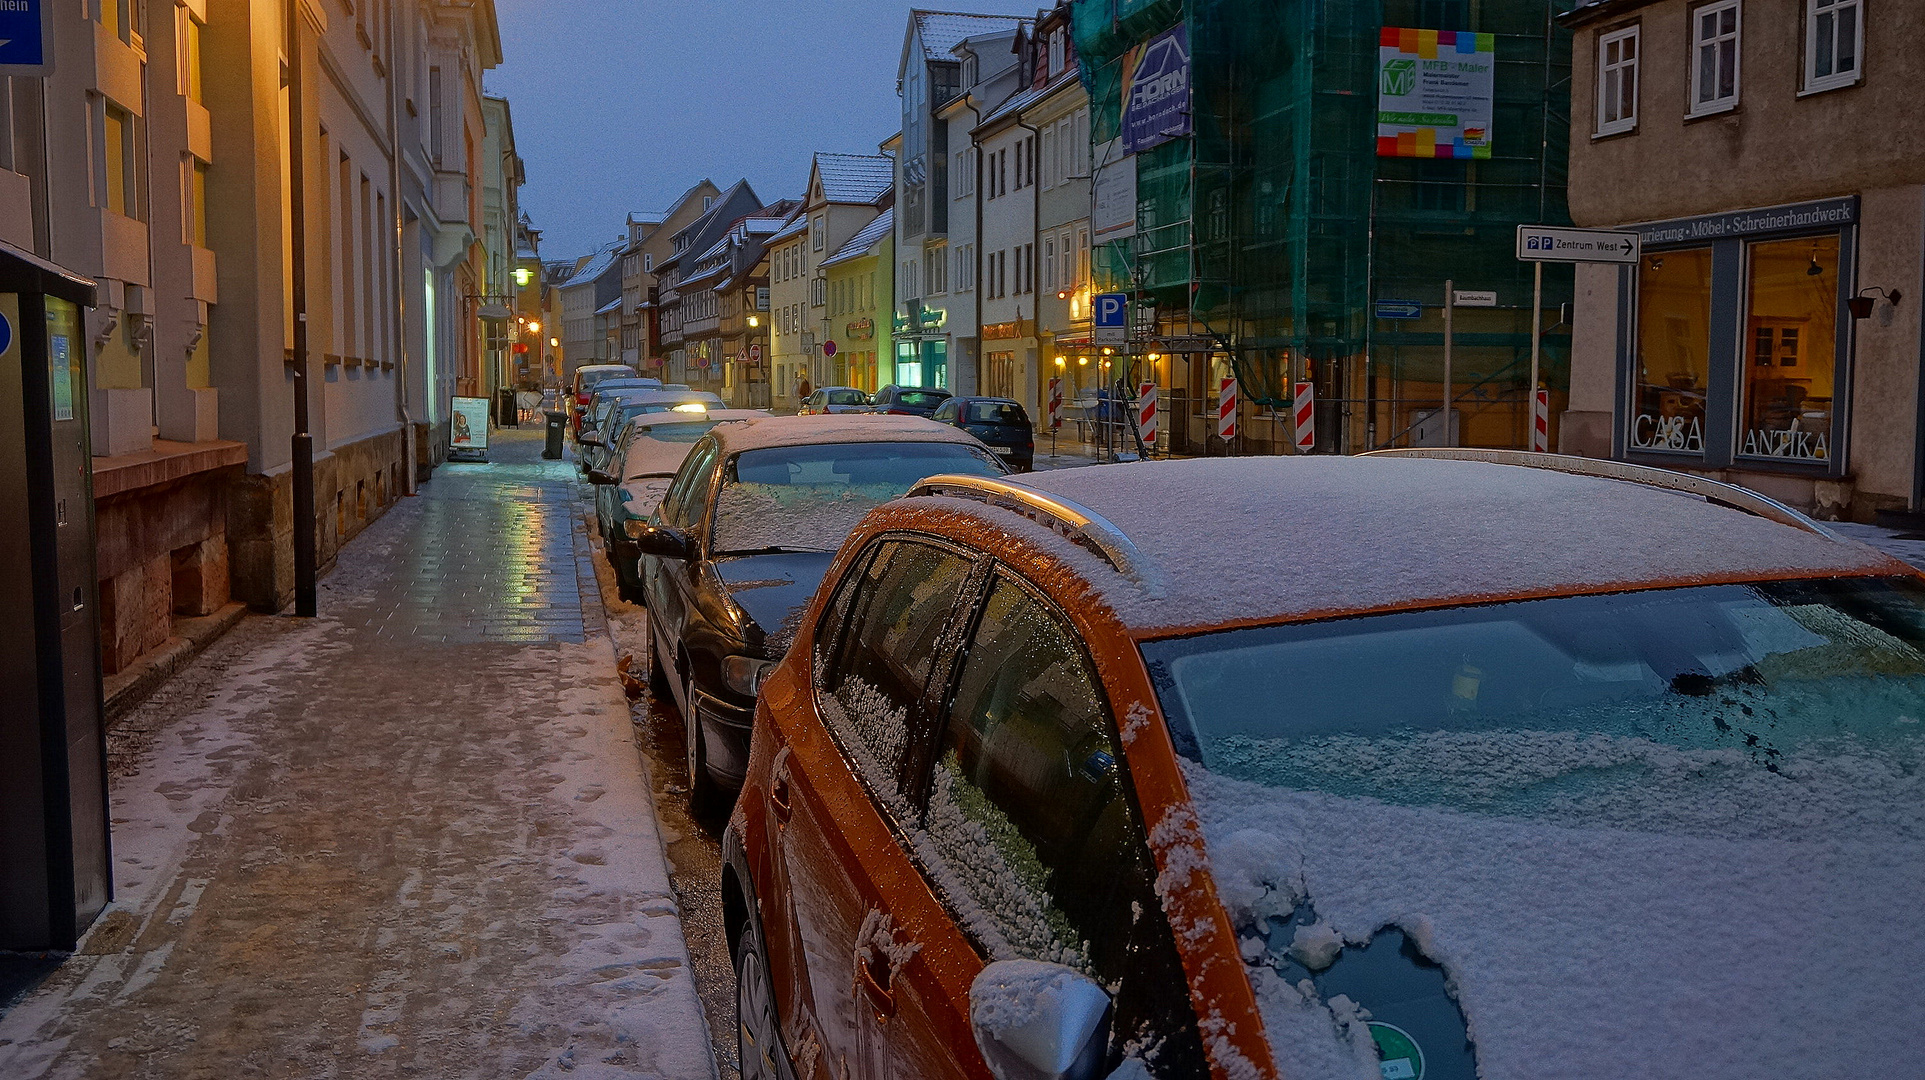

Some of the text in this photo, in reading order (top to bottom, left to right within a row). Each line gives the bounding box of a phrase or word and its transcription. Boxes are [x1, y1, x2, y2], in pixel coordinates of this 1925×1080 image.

[1422, 60, 1449, 71] MFB
[1458, 62, 1489, 73] Maler
[1131, 65, 1187, 106] HORN
[1690, 219, 1726, 238] Möbel
[1732, 204, 1851, 231] Schreinerhandwerk
[1556, 239, 1593, 251] Zentrum
[1597, 241, 1618, 252] West
[1101, 298, 1120, 323] P
[1634, 414, 1705, 452] CASA
[1741, 428, 1829, 459] ANTIKA
